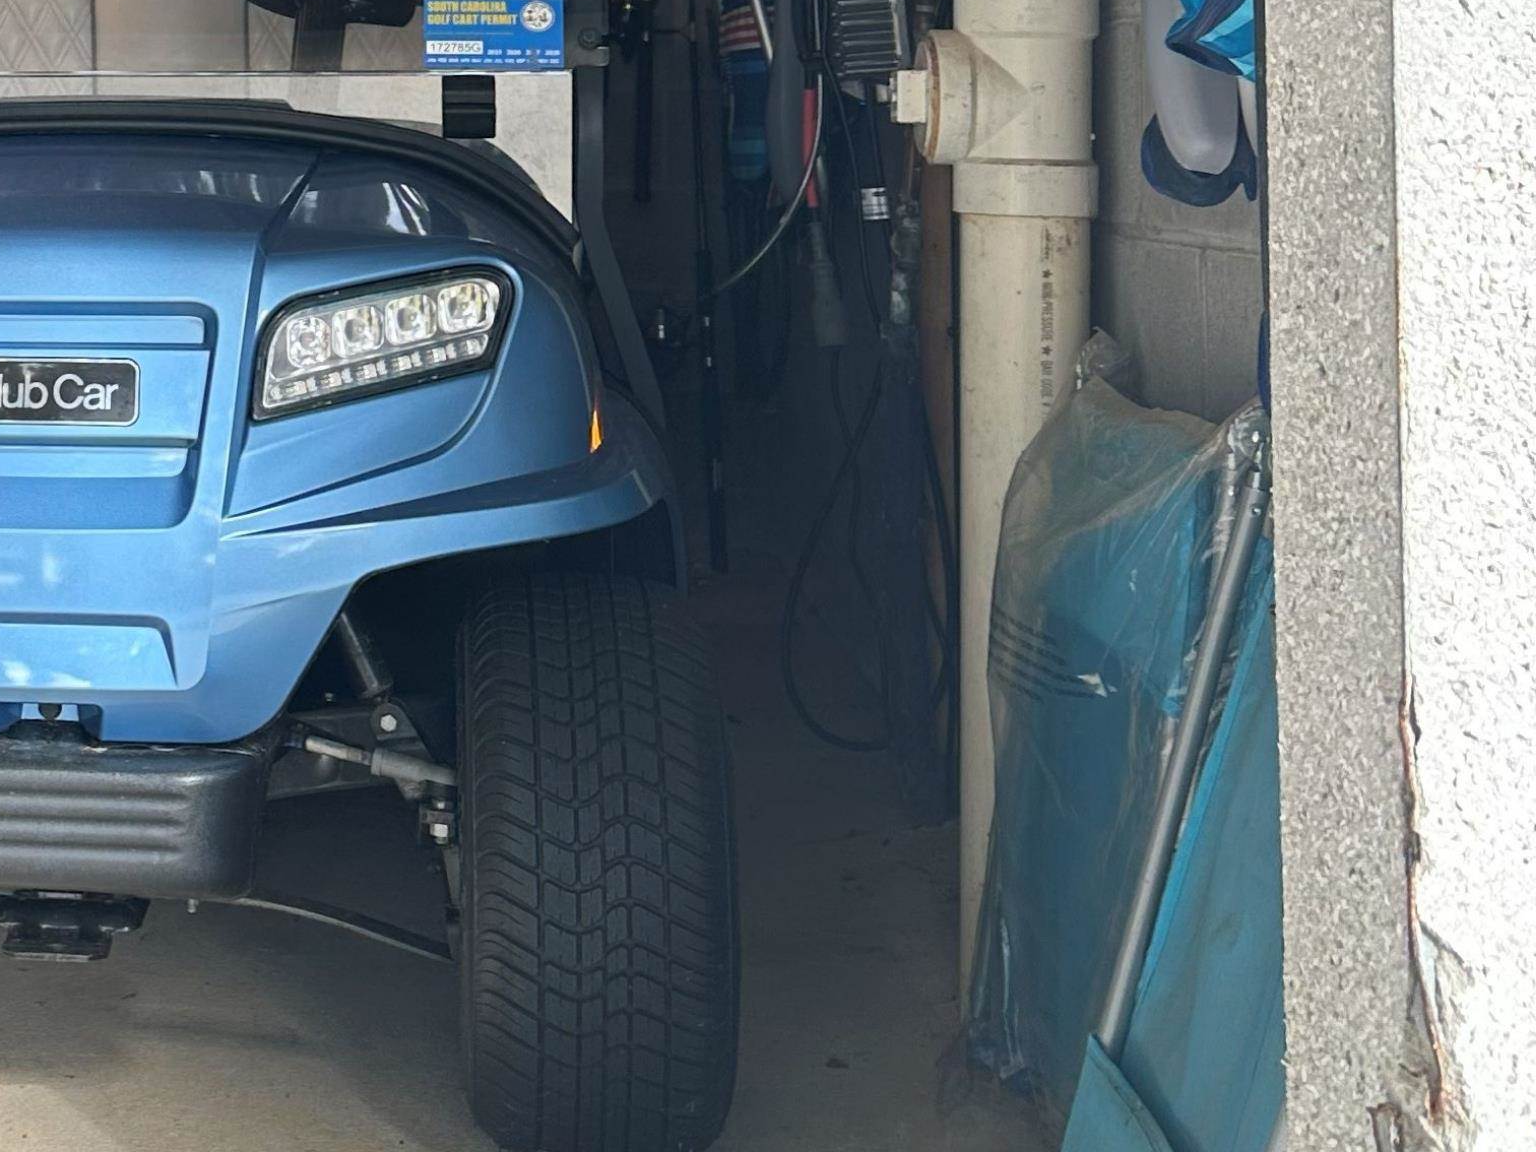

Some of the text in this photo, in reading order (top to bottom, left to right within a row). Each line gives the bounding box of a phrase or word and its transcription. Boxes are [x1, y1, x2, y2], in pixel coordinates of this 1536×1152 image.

[427, 0, 508, 12] SOUTH CAROLINA
[427, 13, 518, 25] GOLF CART PERMIT
[53, 373, 119, 410] Car
